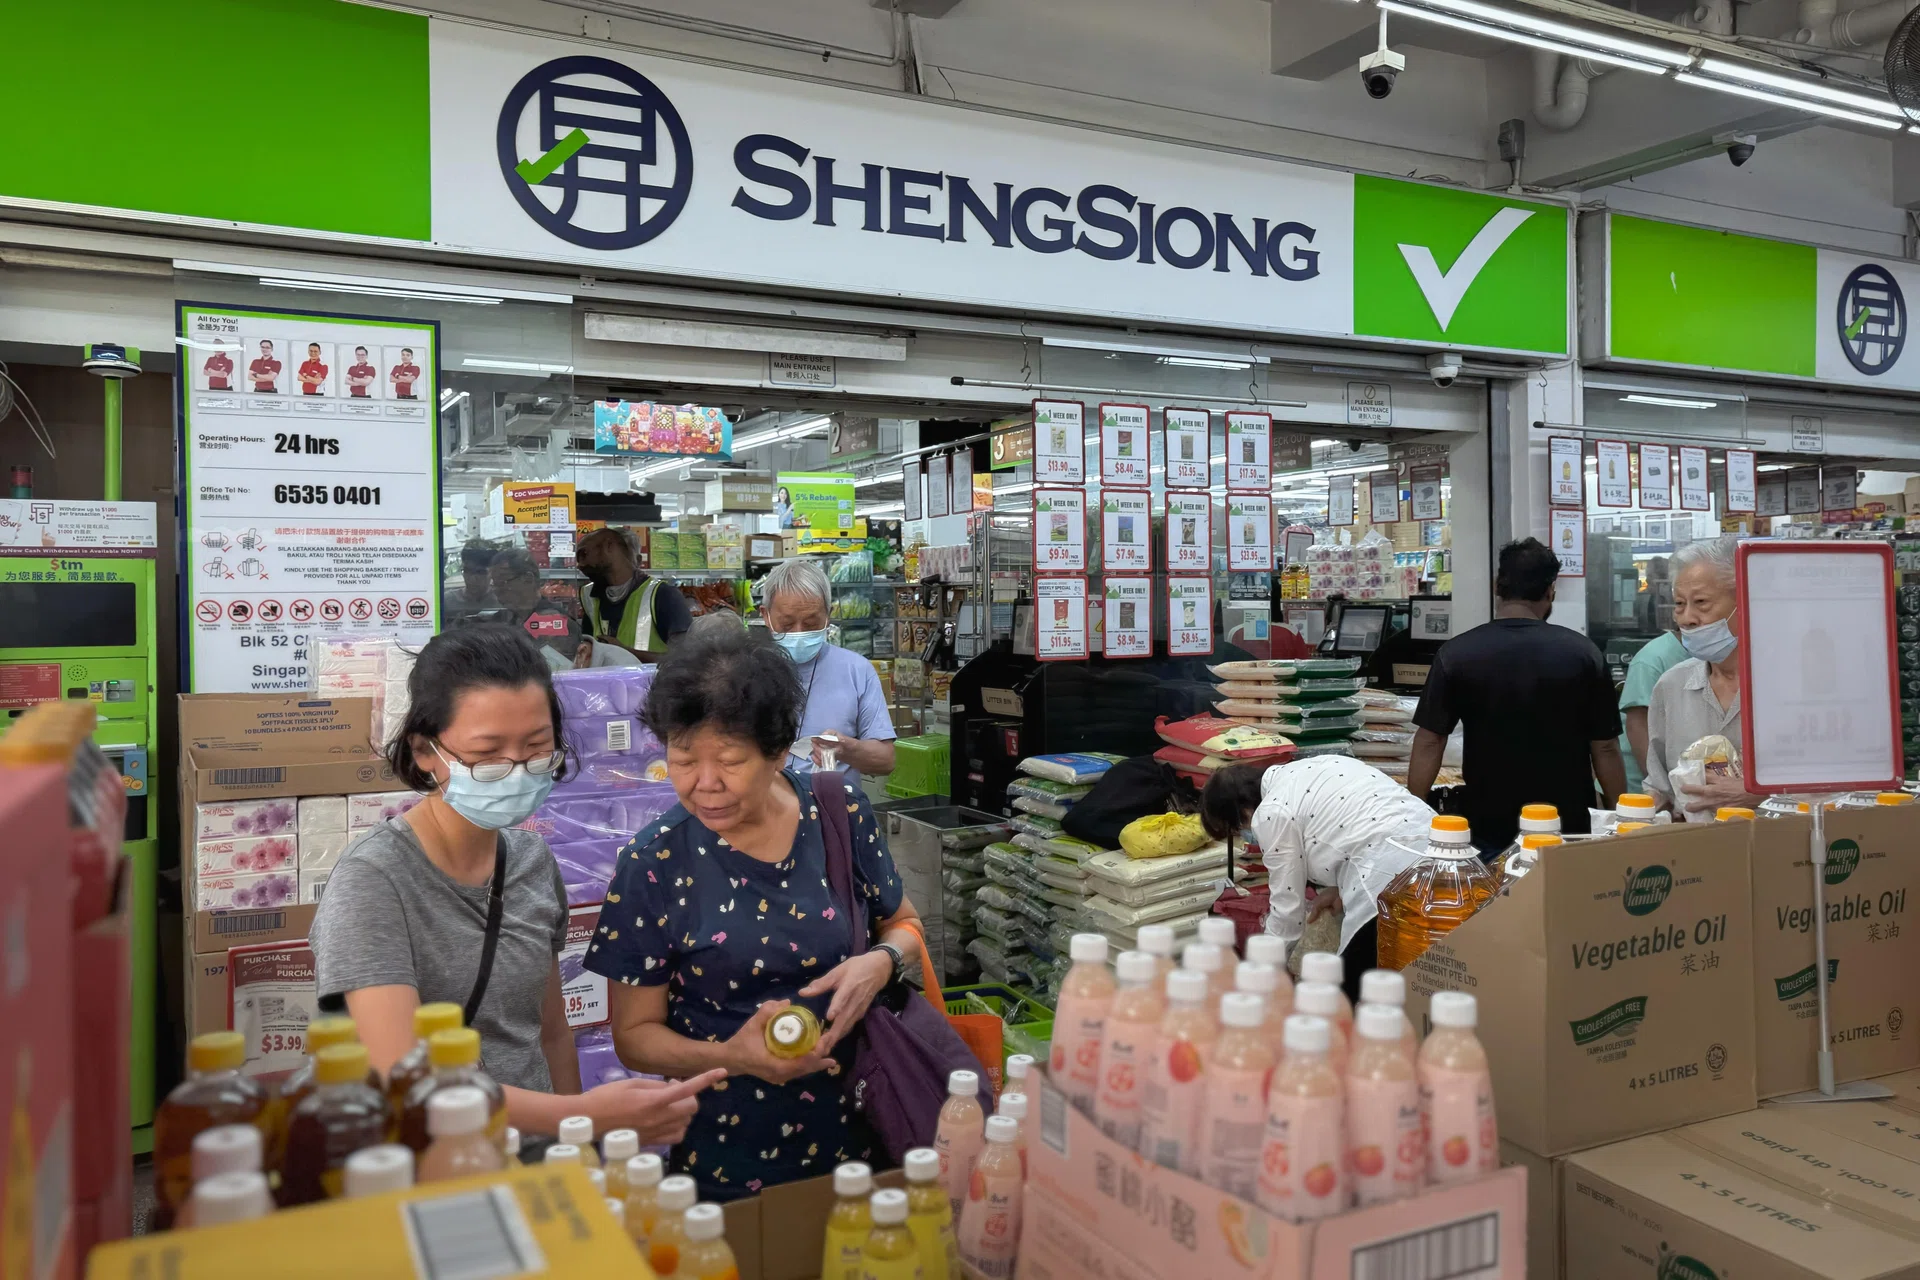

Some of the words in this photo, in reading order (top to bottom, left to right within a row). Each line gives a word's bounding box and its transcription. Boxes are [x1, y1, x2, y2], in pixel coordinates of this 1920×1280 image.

[793, 364, 831, 372] ENTRANCE
[1255, 423, 1265, 431] ONLY
[199, 434, 239, 443] Operating
[240, 435, 265, 443] Hours:
[275, 433, 301, 453] 24
[305, 435, 340, 455] hrs
[832, 422, 841, 454] 2
[1048, 460, 1068, 472] $13.90
[1115, 461, 1134, 474] $8.40
[1178, 465, 1196, 477] $12.95
[1239, 467, 1257, 479] $17.50
[200, 486, 222, 494] Office
[237, 486, 251, 494] No:
[274, 484, 329, 505] 6535
[333, 486, 381, 505] 0401
[517, 504, 547, 513] Accepted
[1049, 548, 1069, 561] $9.50
[1116, 548, 1135, 561] $7.90
[1179, 548, 1197, 561] $9.90
[1240, 549, 1258, 561] $23.95
[1135, 587, 1146, 595] ONLY
[240, 635, 267, 648] Blk
[271, 635, 288, 648] 52
[1050, 635, 1072, 648] $11.95
[1117, 634, 1136, 647] $8.90
[1181, 632, 1199, 644] $8.95
[986, 696, 1002, 704] LITTER
[1632, 873, 1671, 891] happy
[1627, 890, 1668, 908] family
[1777, 893, 1871, 933] Vegtable
[1879, 888, 1906, 916] Oil
[1866, 921, 1900, 943] 菜油
[1571, 920, 1686, 971] Vegetable
[1694, 914, 1727, 946] Oil
[244, 955, 291, 964] PURCHASE
[1426, 951, 1467, 972] MARKETING
[1679, 950, 1721, 976] 菜油
[1577, 1010, 1624, 1036] CHOLESTEROL
[1625, 1001, 1641, 1015] FREE
[1839, 1030, 1844, 1042] 5
[1846, 1024, 1880, 1041] LITRES
[1628, 1077, 1637, 1090] 4
[1648, 1072, 1656, 1086] 5
[1658, 1063, 1699, 1084] LITRES
[1678, 1173, 1697, 1181] 4
[1713, 1189, 1735, 1197] 5
[1732, 1197, 1823, 1232] LITRES
